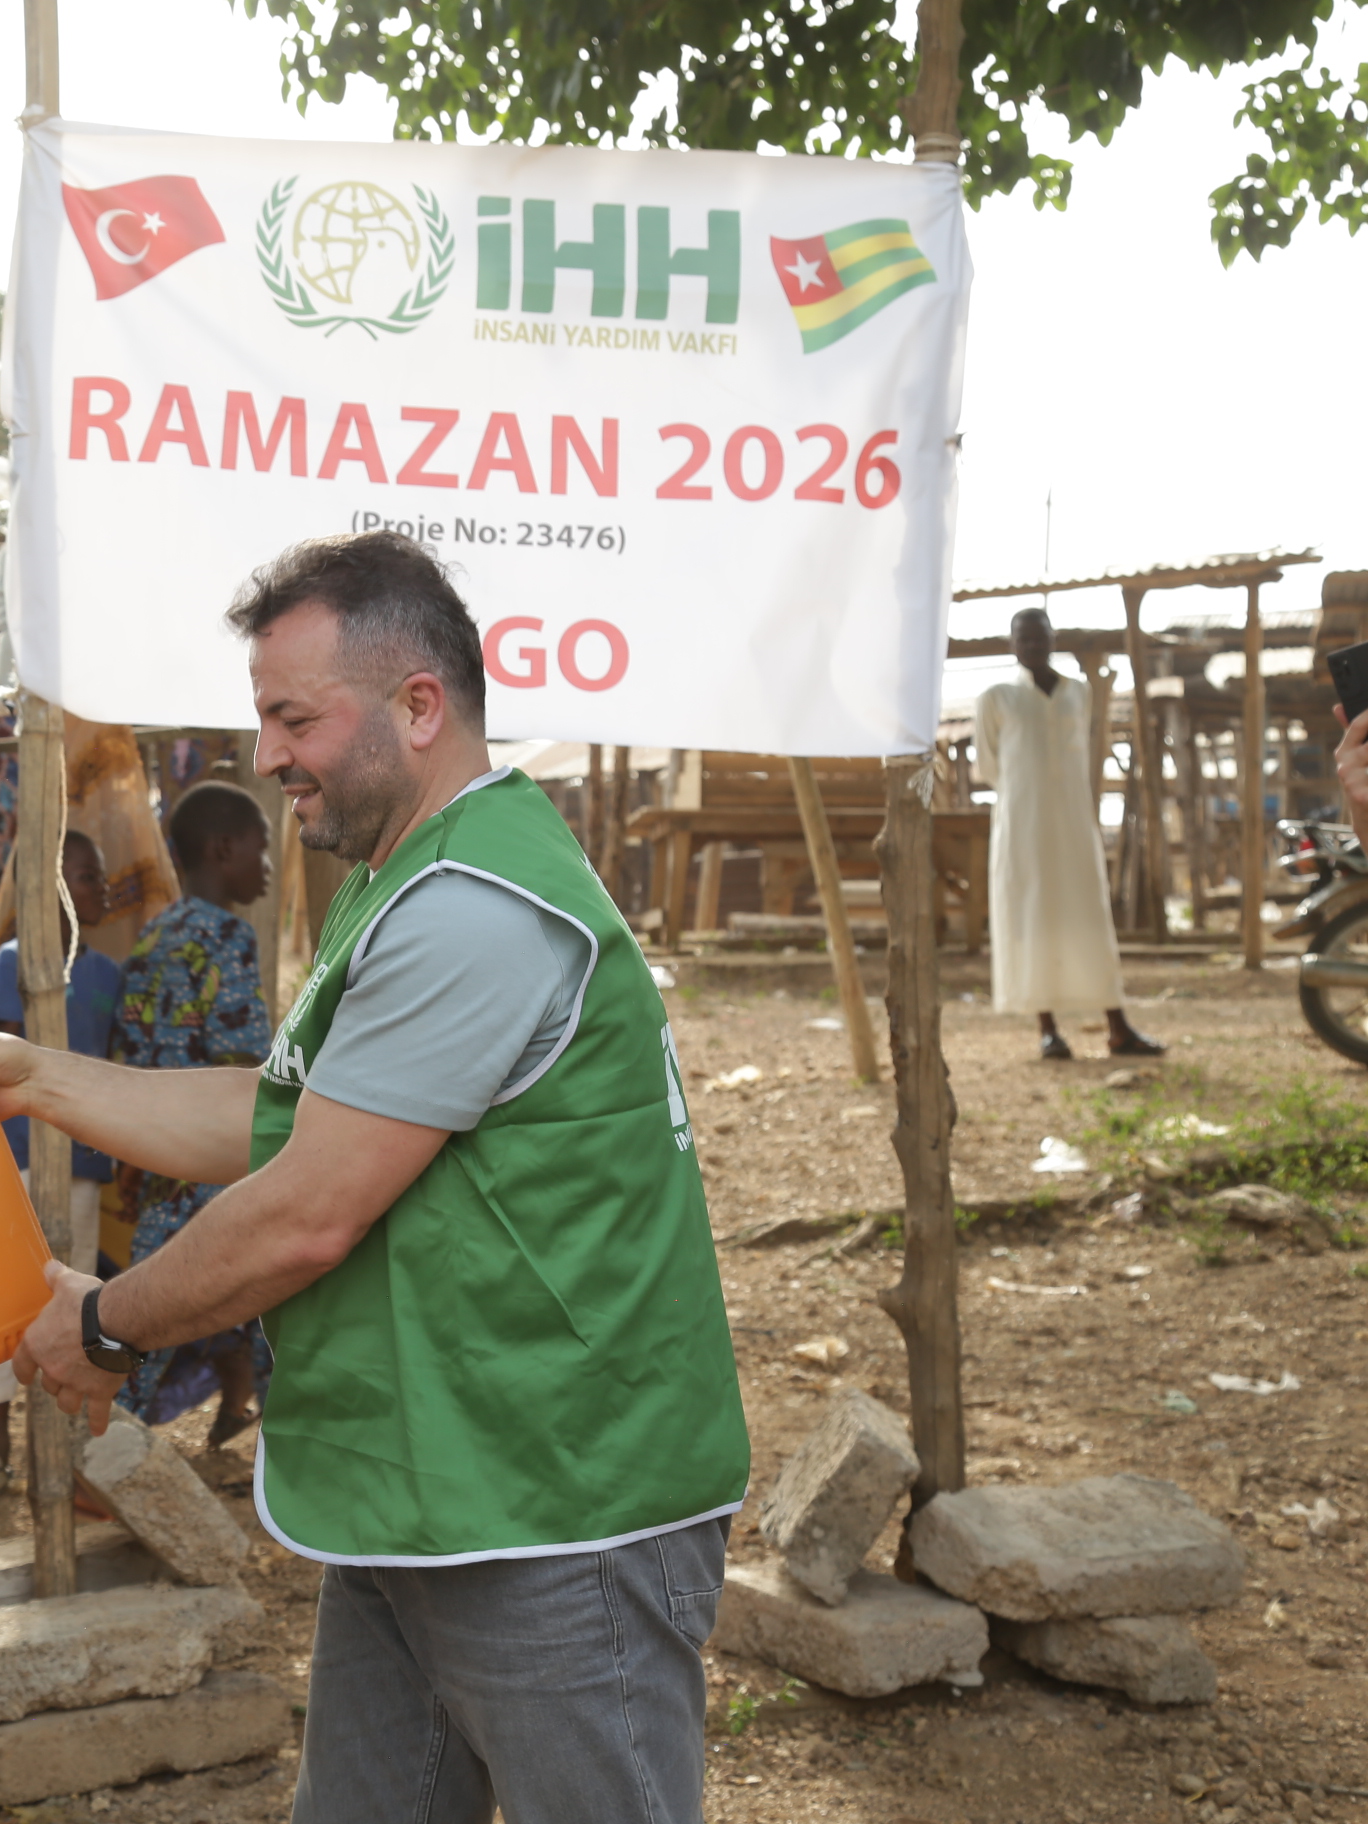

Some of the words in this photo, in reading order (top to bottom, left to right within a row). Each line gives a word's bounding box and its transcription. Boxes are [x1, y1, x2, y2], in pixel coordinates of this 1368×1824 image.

[563, 324, 660, 351] YARDIM
[667, 331, 738, 356] VAKFI
[68, 376, 619, 498] RAMAZAN
[656, 422, 901, 510] 2026
[454, 517, 507, 545] No:
[516, 522, 626, 555] 23476)
[482, 615, 630, 692] GO
